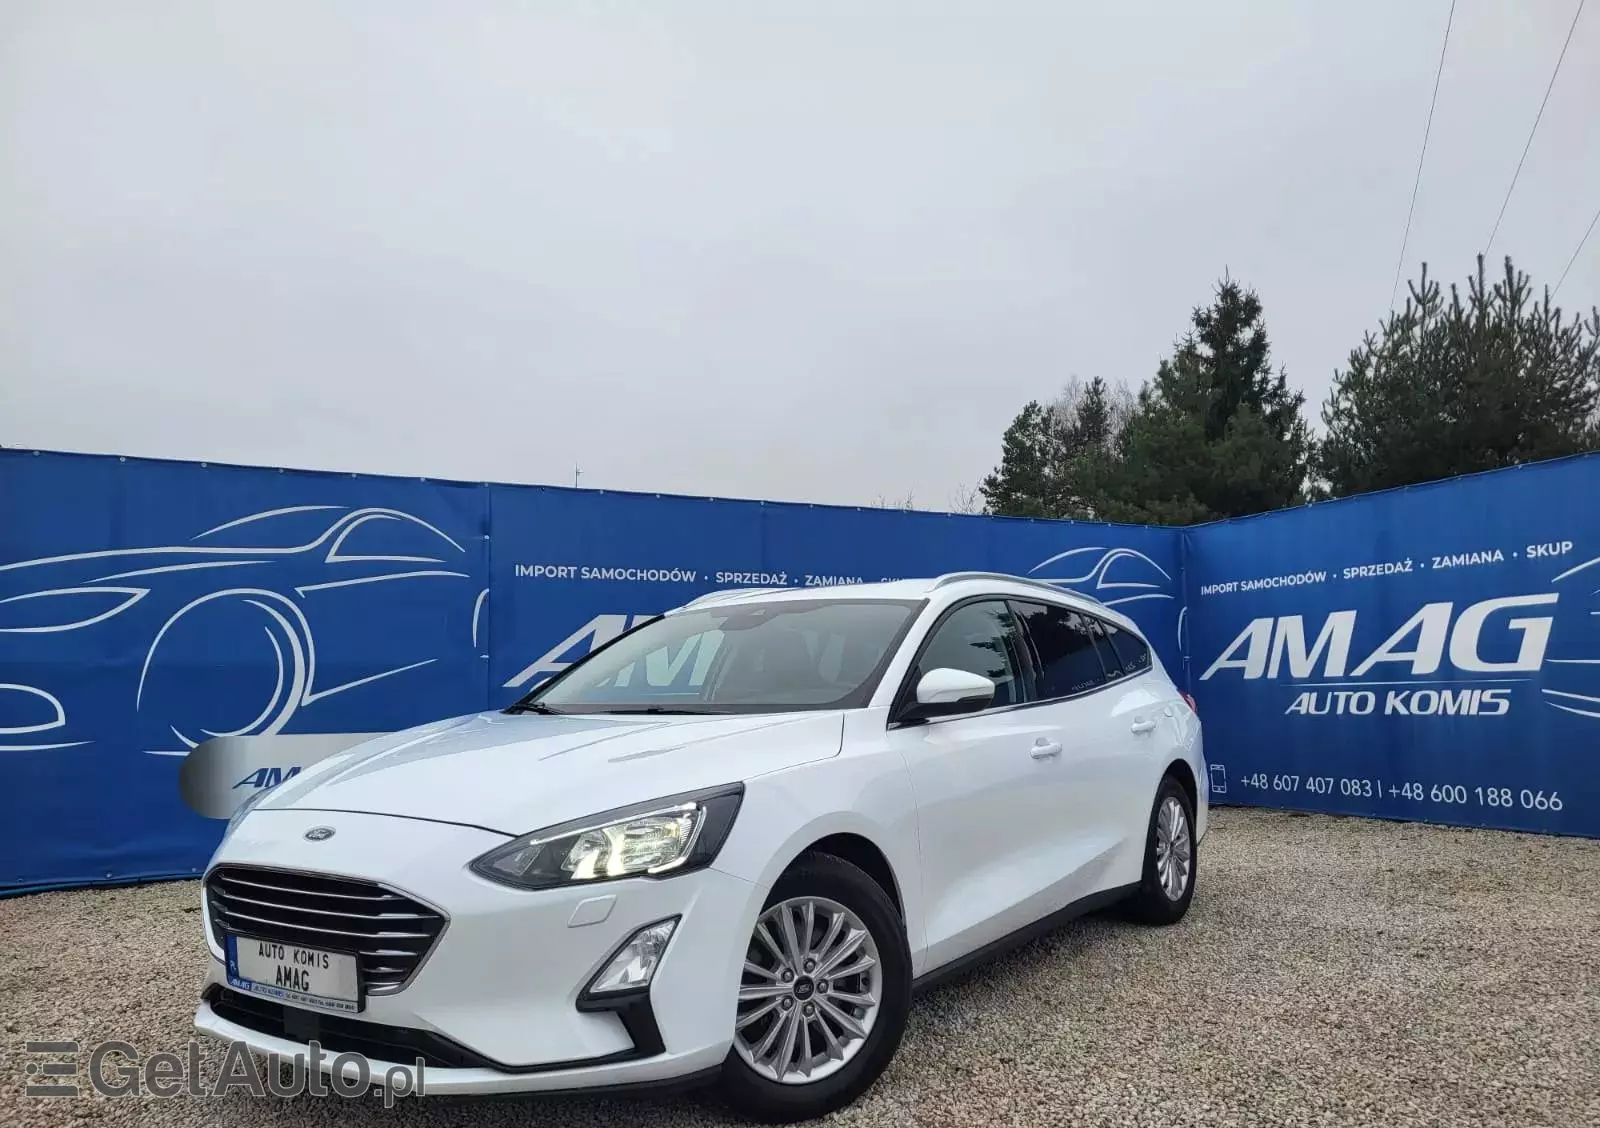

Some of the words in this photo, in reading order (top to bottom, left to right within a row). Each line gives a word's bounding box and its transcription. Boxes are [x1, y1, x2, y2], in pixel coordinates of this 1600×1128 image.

[514, 564, 578, 579] IMPORT
[580, 565, 697, 583] SAMOCHODÓW
[715, 569, 788, 586] SPRZEDAŻ
[1200, 581, 1239, 596] IMPORT
[1240, 569, 1327, 592] SAMOCHODÓW
[1343, 556, 1414, 580] SPRZEDAŻ
[1431, 548, 1505, 570] ZAMIANA
[1526, 540, 1574, 559] SKUP
[1285, 690, 1376, 716] AUTO
[1383, 688, 1512, 716] KOMIS
[1241, 774, 1269, 790] +48
[1273, 775, 1300, 793] 607
[1306, 777, 1334, 795] 407
[1340, 779, 1372, 798] 083
[1388, 784, 1424, 802] +48
[1430, 785, 1468, 804] 600
[1474, 787, 1513, 808] 188
[1520, 790, 1563, 811] 066
[258, 943, 285, 960] AUTO
[293, 948, 329, 969] KOMIS
[275, 965, 310, 991] AMAG
